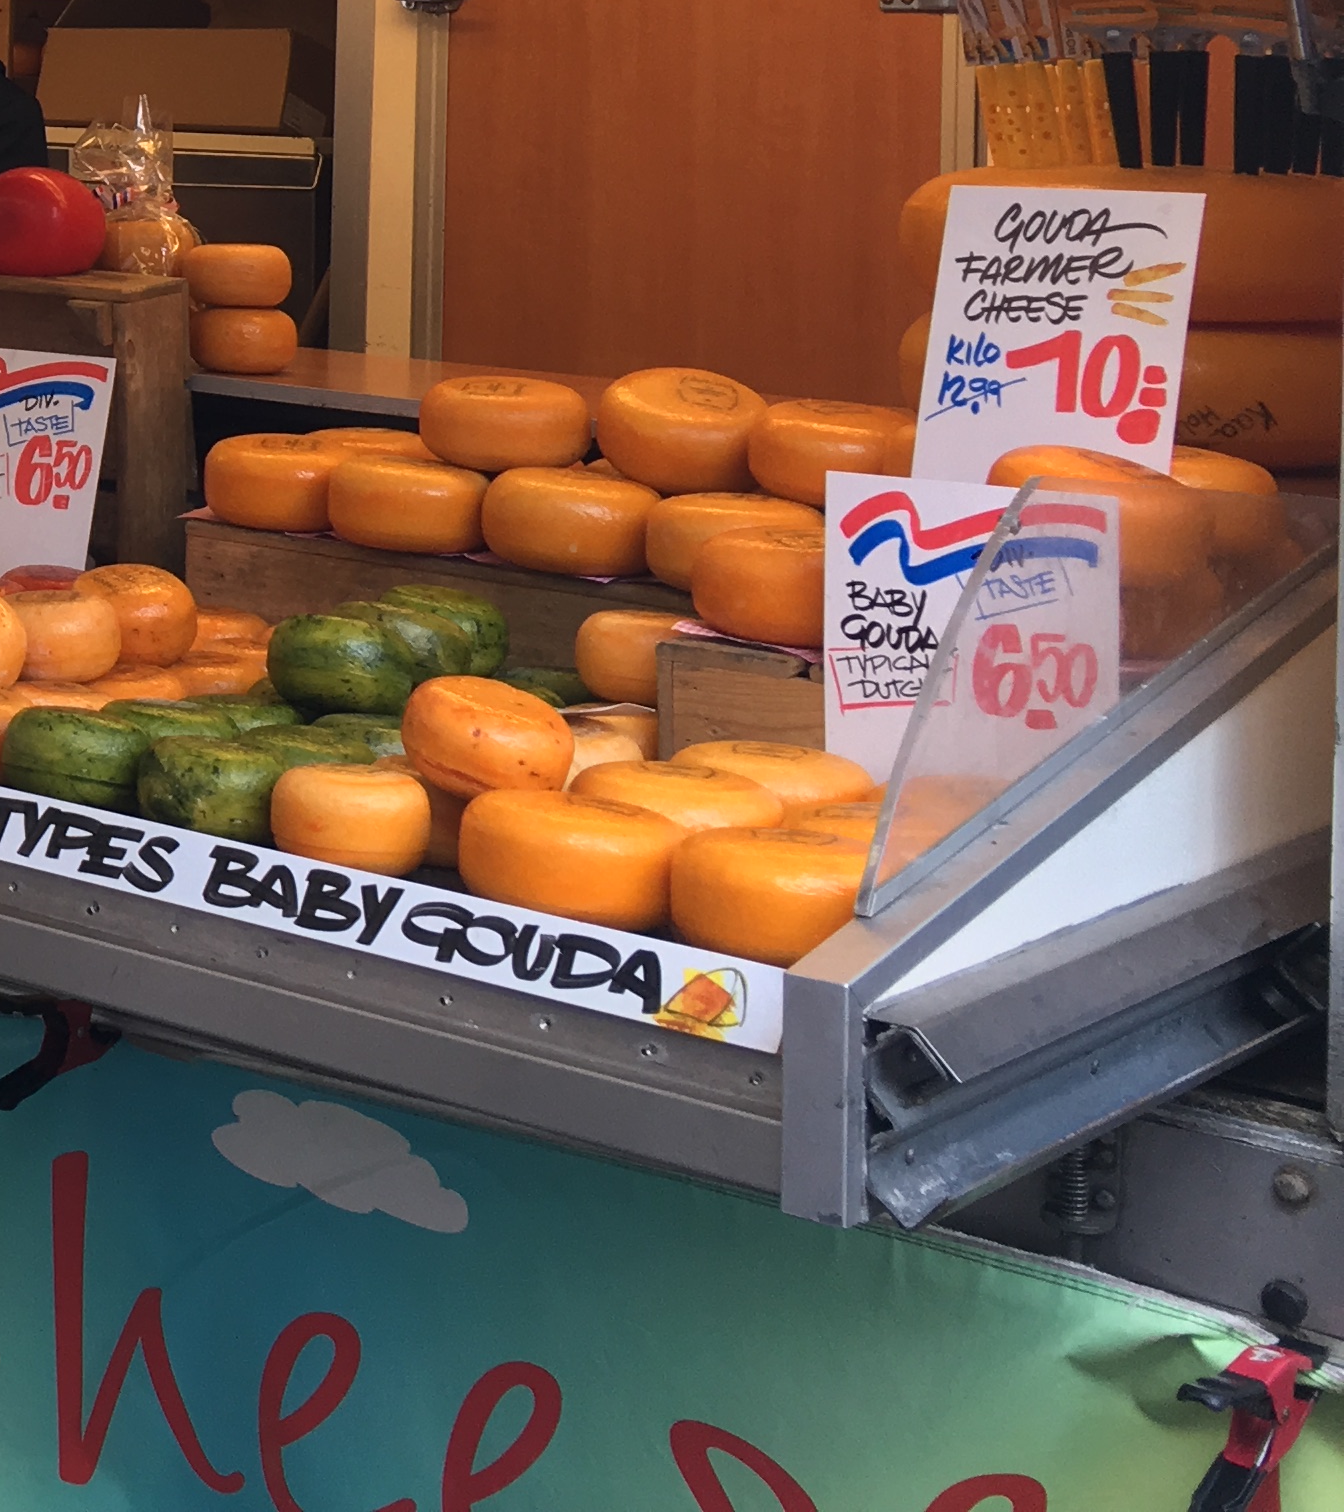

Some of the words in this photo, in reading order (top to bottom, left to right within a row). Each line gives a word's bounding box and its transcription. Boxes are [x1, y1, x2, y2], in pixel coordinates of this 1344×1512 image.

[994, 203, 1168, 247] GOUDA
[955, 246, 1134, 285] FARMER
[963, 290, 1089, 324] CHEESE
[946, 333, 1001, 367] KILO
[20, 391, 59, 412] DIV.
[10, 414, 70, 436] TASTE
[982, 571, 1055, 600] TASTE
[846, 580, 927, 628] BABY
[840, 614, 939, 652] GOUDA
[204, 844, 406, 948] BABY
[399, 900, 666, 1014] GOUDA
